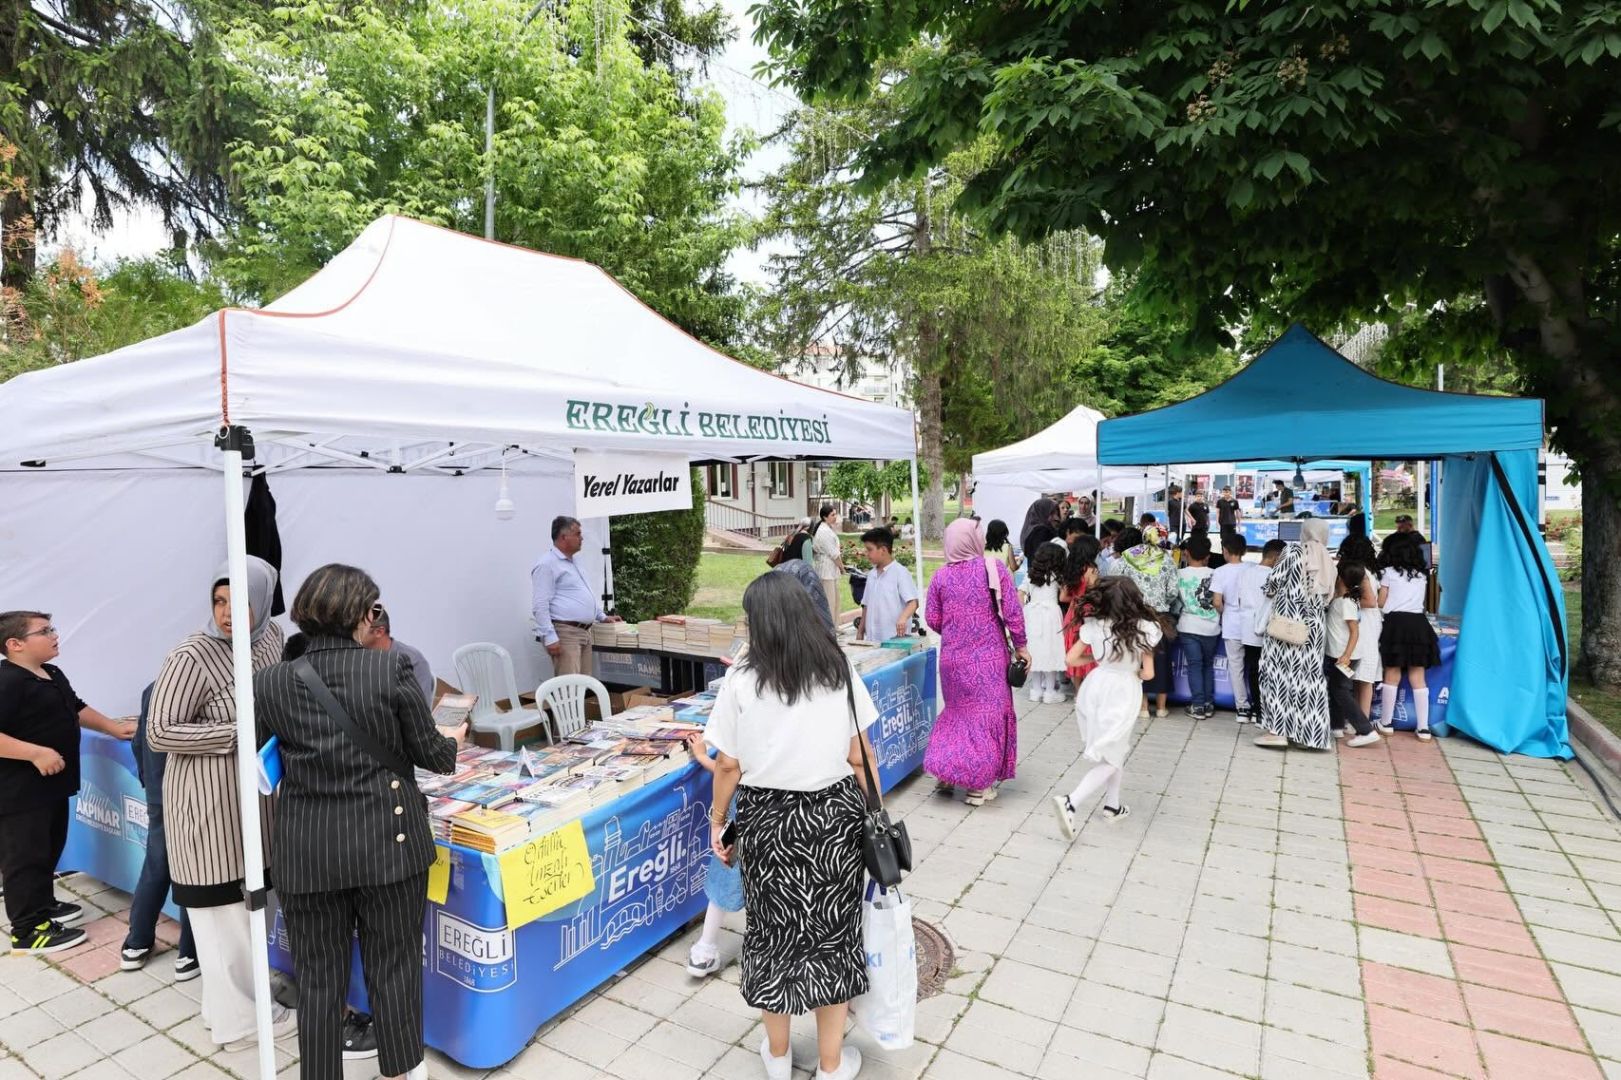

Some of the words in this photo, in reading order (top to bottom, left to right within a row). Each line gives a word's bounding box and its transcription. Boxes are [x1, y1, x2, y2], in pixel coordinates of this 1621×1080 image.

[566, 400, 693, 437] EREĞLİ
[698, 408, 832, 443] BELEDİYESİ
[583, 474, 621, 498] Yerel
[622, 471, 679, 496] Yazarlar
[76, 797, 120, 829] AKPINAR
[128, 804, 148, 822] ERE
[444, 924, 506, 959] EREĞLİ
